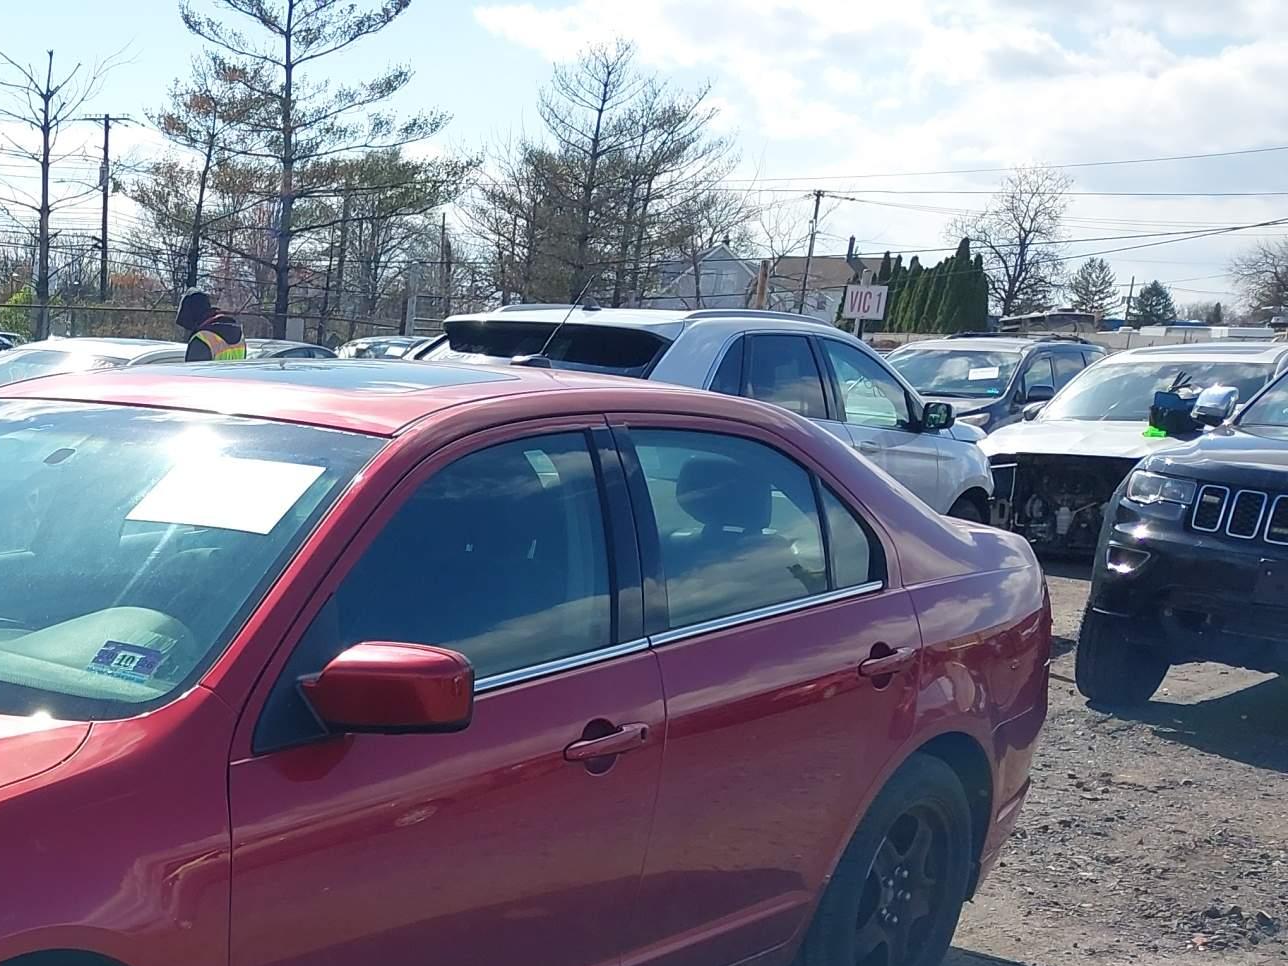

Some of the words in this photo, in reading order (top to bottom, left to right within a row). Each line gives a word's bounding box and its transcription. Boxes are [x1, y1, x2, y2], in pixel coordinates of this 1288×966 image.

[850, 291, 872, 313] VIC
[876, 291, 883, 313] 1
[114, 654, 136, 668] 10
